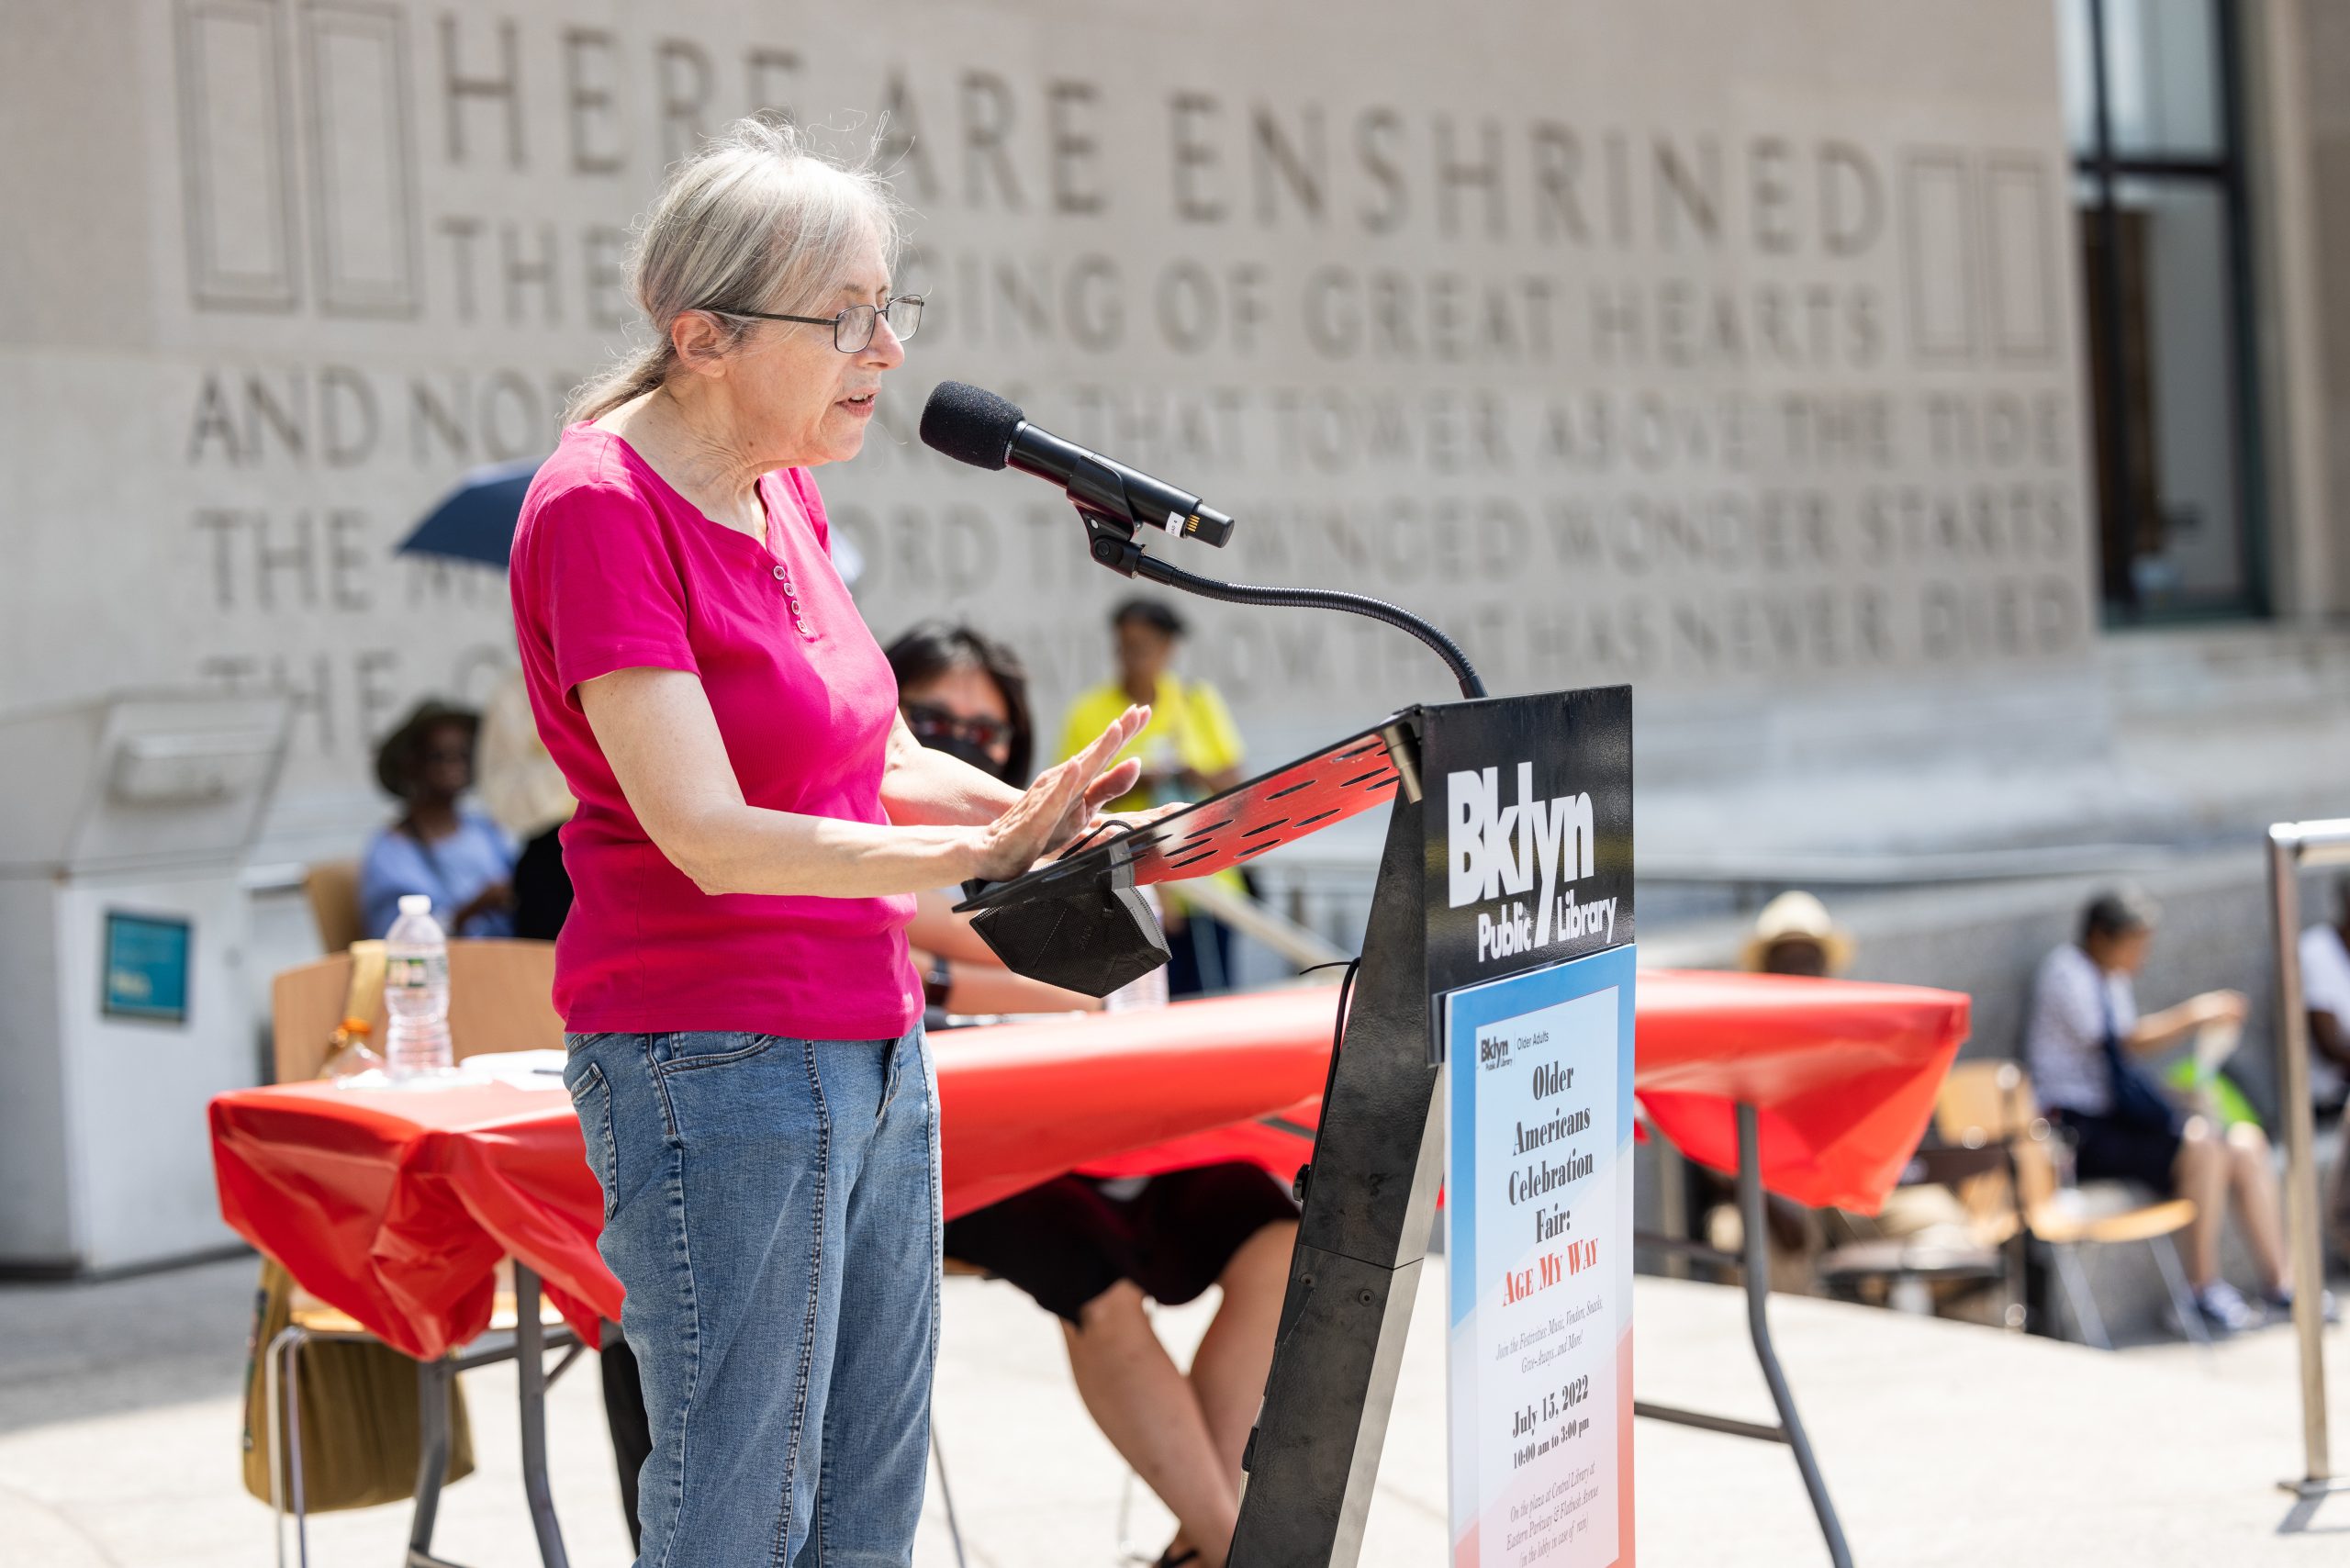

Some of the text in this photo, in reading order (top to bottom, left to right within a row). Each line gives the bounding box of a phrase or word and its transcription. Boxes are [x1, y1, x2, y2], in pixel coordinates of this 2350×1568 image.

[870, 58, 1112, 226] ARE
[1167, 83, 1887, 260] ENSHRINED
[435, 215, 631, 333] THE
[1152, 255, 1274, 360] OF
[1300, 263, 1557, 365] GREAT
[1586, 277, 1885, 371] HEARTS
[185, 365, 381, 469] AND
[1061, 384, 1247, 472] THAT
[1265, 386, 1516, 476] TOWER
[1537, 387, 1750, 476] ABOVE
[1774, 386, 1897, 473] THE
[1920, 386, 2069, 472] TIDE
[189, 506, 374, 613] THE
[1544, 487, 1841, 578] WONDER
[1855, 481, 2072, 571] STARTS
[1525, 593, 1660, 677] HAS
[1667, 578, 1889, 676] NEVER
[1916, 569, 2082, 665] DIED
[1448, 761, 1594, 947] Bklyn
[1478, 889, 1617, 962] Public Library
[1481, 1031, 1550, 1068] Bklyn Older Adults
[1533, 1060, 1574, 1101] Older
[1513, 1107, 1591, 1157] Americans
[1508, 1148, 1594, 1205] Celebration
[1535, 1203, 1571, 1244] Fair:
[1495, 1342, 1509, 1361] Join
[1510, 1336, 1518, 1354] the
[1568, 1329, 1583, 1351] More!
[1513, 1374, 1588, 1438] July 15, 2022
[1514, 1417, 1589, 1469] 10:00 am to 3:00 pm
[1506, 1485, 1599, 1551] Eastern Parkway & Flatbush Avenue
[1510, 1460, 1595, 1523] On the plaza at Central Library at
[1528, 1545, 1537, 1563] the
[1537, 1537, 1551, 1557] lobby
[1551, 1536, 1558, 1550] in
[1558, 1532, 1569, 1545] case
[1569, 1519, 1576, 1543] of
